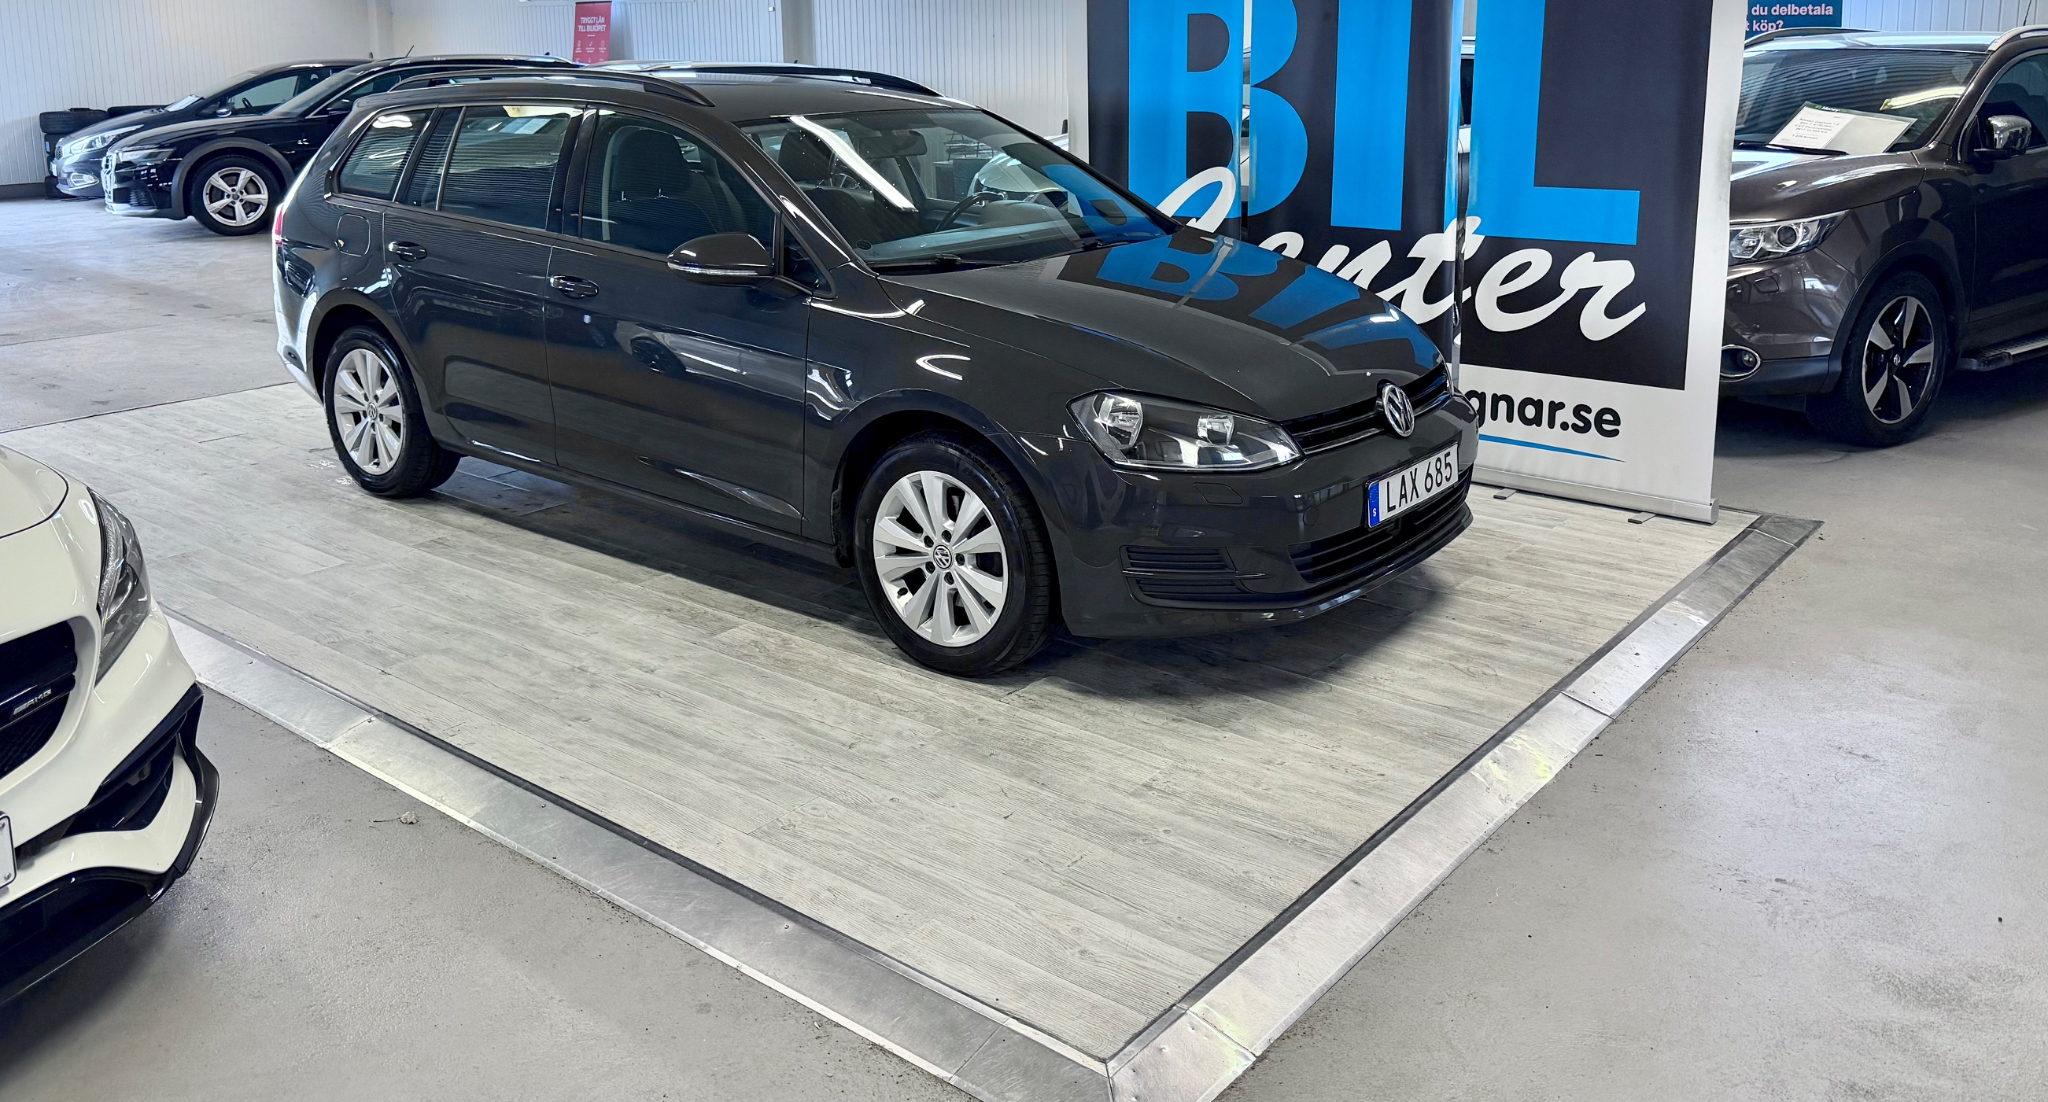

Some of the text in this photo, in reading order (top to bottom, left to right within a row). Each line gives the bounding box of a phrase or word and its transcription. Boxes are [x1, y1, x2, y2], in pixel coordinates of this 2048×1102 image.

[1751, 3, 1833, 15] du delbetala
[1752, 19, 1784, 32] köp?
[1128, 0, 1640, 244] BIL
[1386, 451, 1453, 513] LAX 685
[1372, 508, 1377, 517] S
